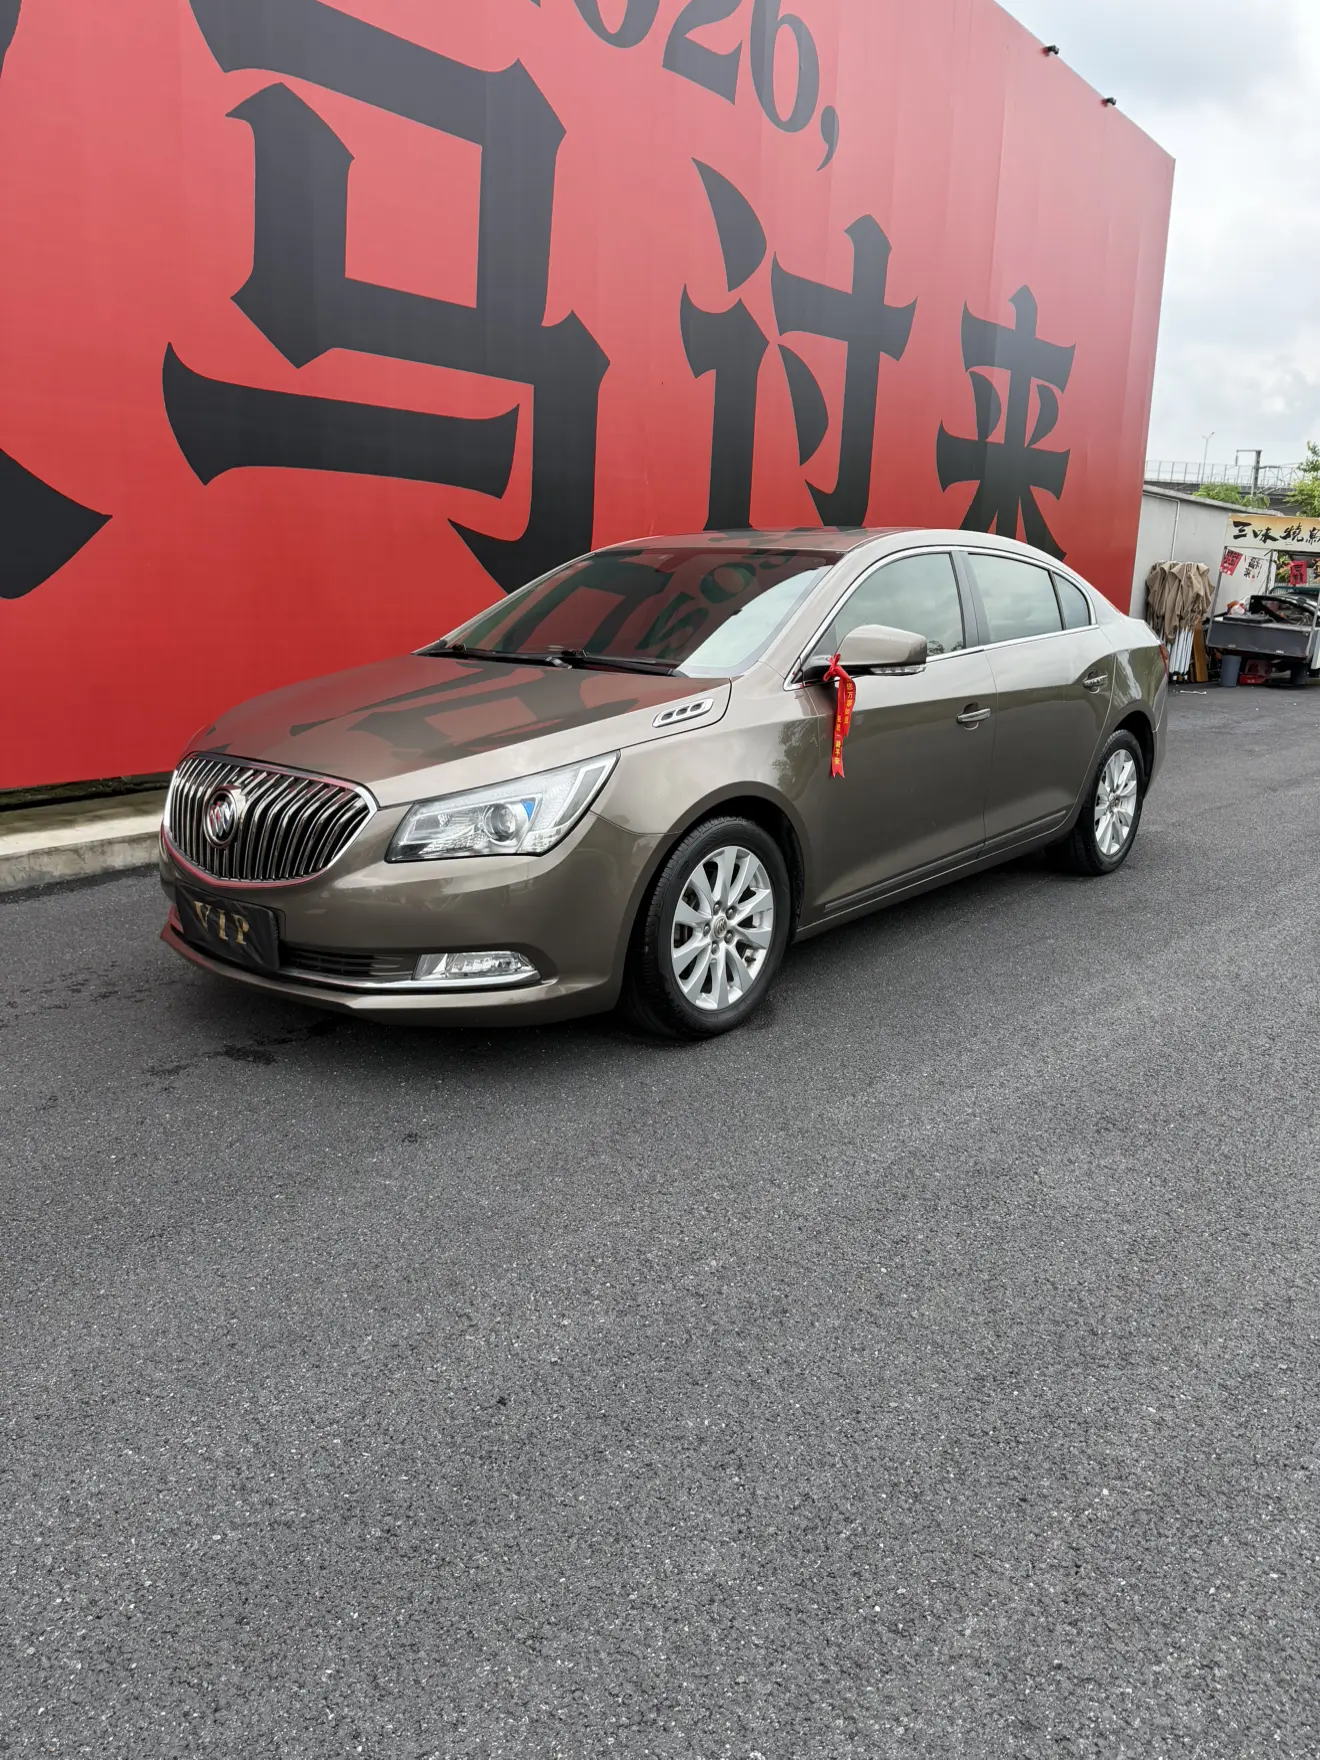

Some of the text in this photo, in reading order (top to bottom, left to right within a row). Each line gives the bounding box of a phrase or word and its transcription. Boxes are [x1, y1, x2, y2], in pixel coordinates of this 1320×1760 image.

[0, 0, 1075, 598] 马过来
[193, 900, 249, 945] VIP
